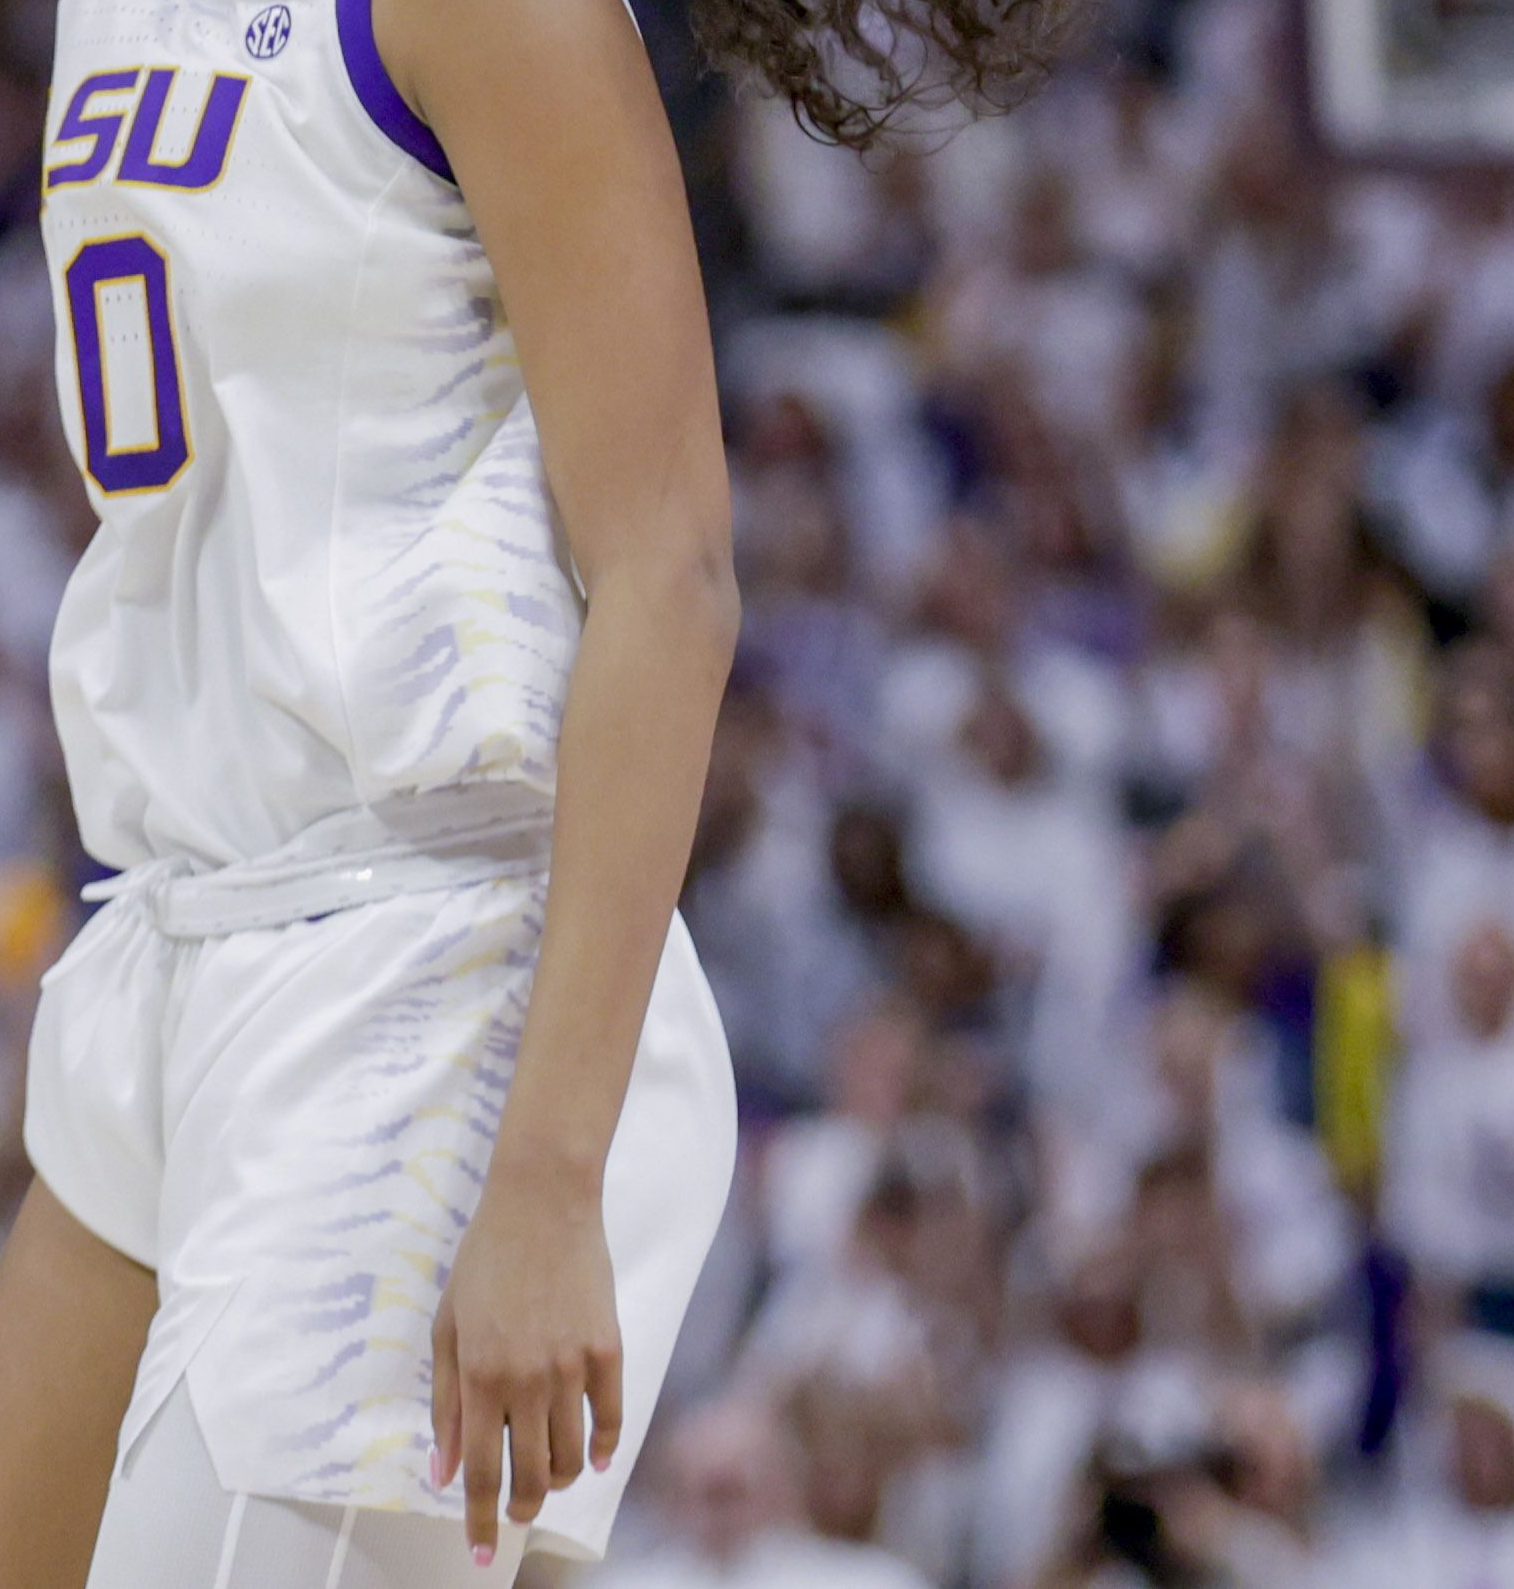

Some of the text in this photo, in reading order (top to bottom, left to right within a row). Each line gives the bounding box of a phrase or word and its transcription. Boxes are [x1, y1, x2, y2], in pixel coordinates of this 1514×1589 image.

[246, 5, 291, 58] SEC
[42, 65, 251, 194] SU
[64, 230, 193, 498] 0
